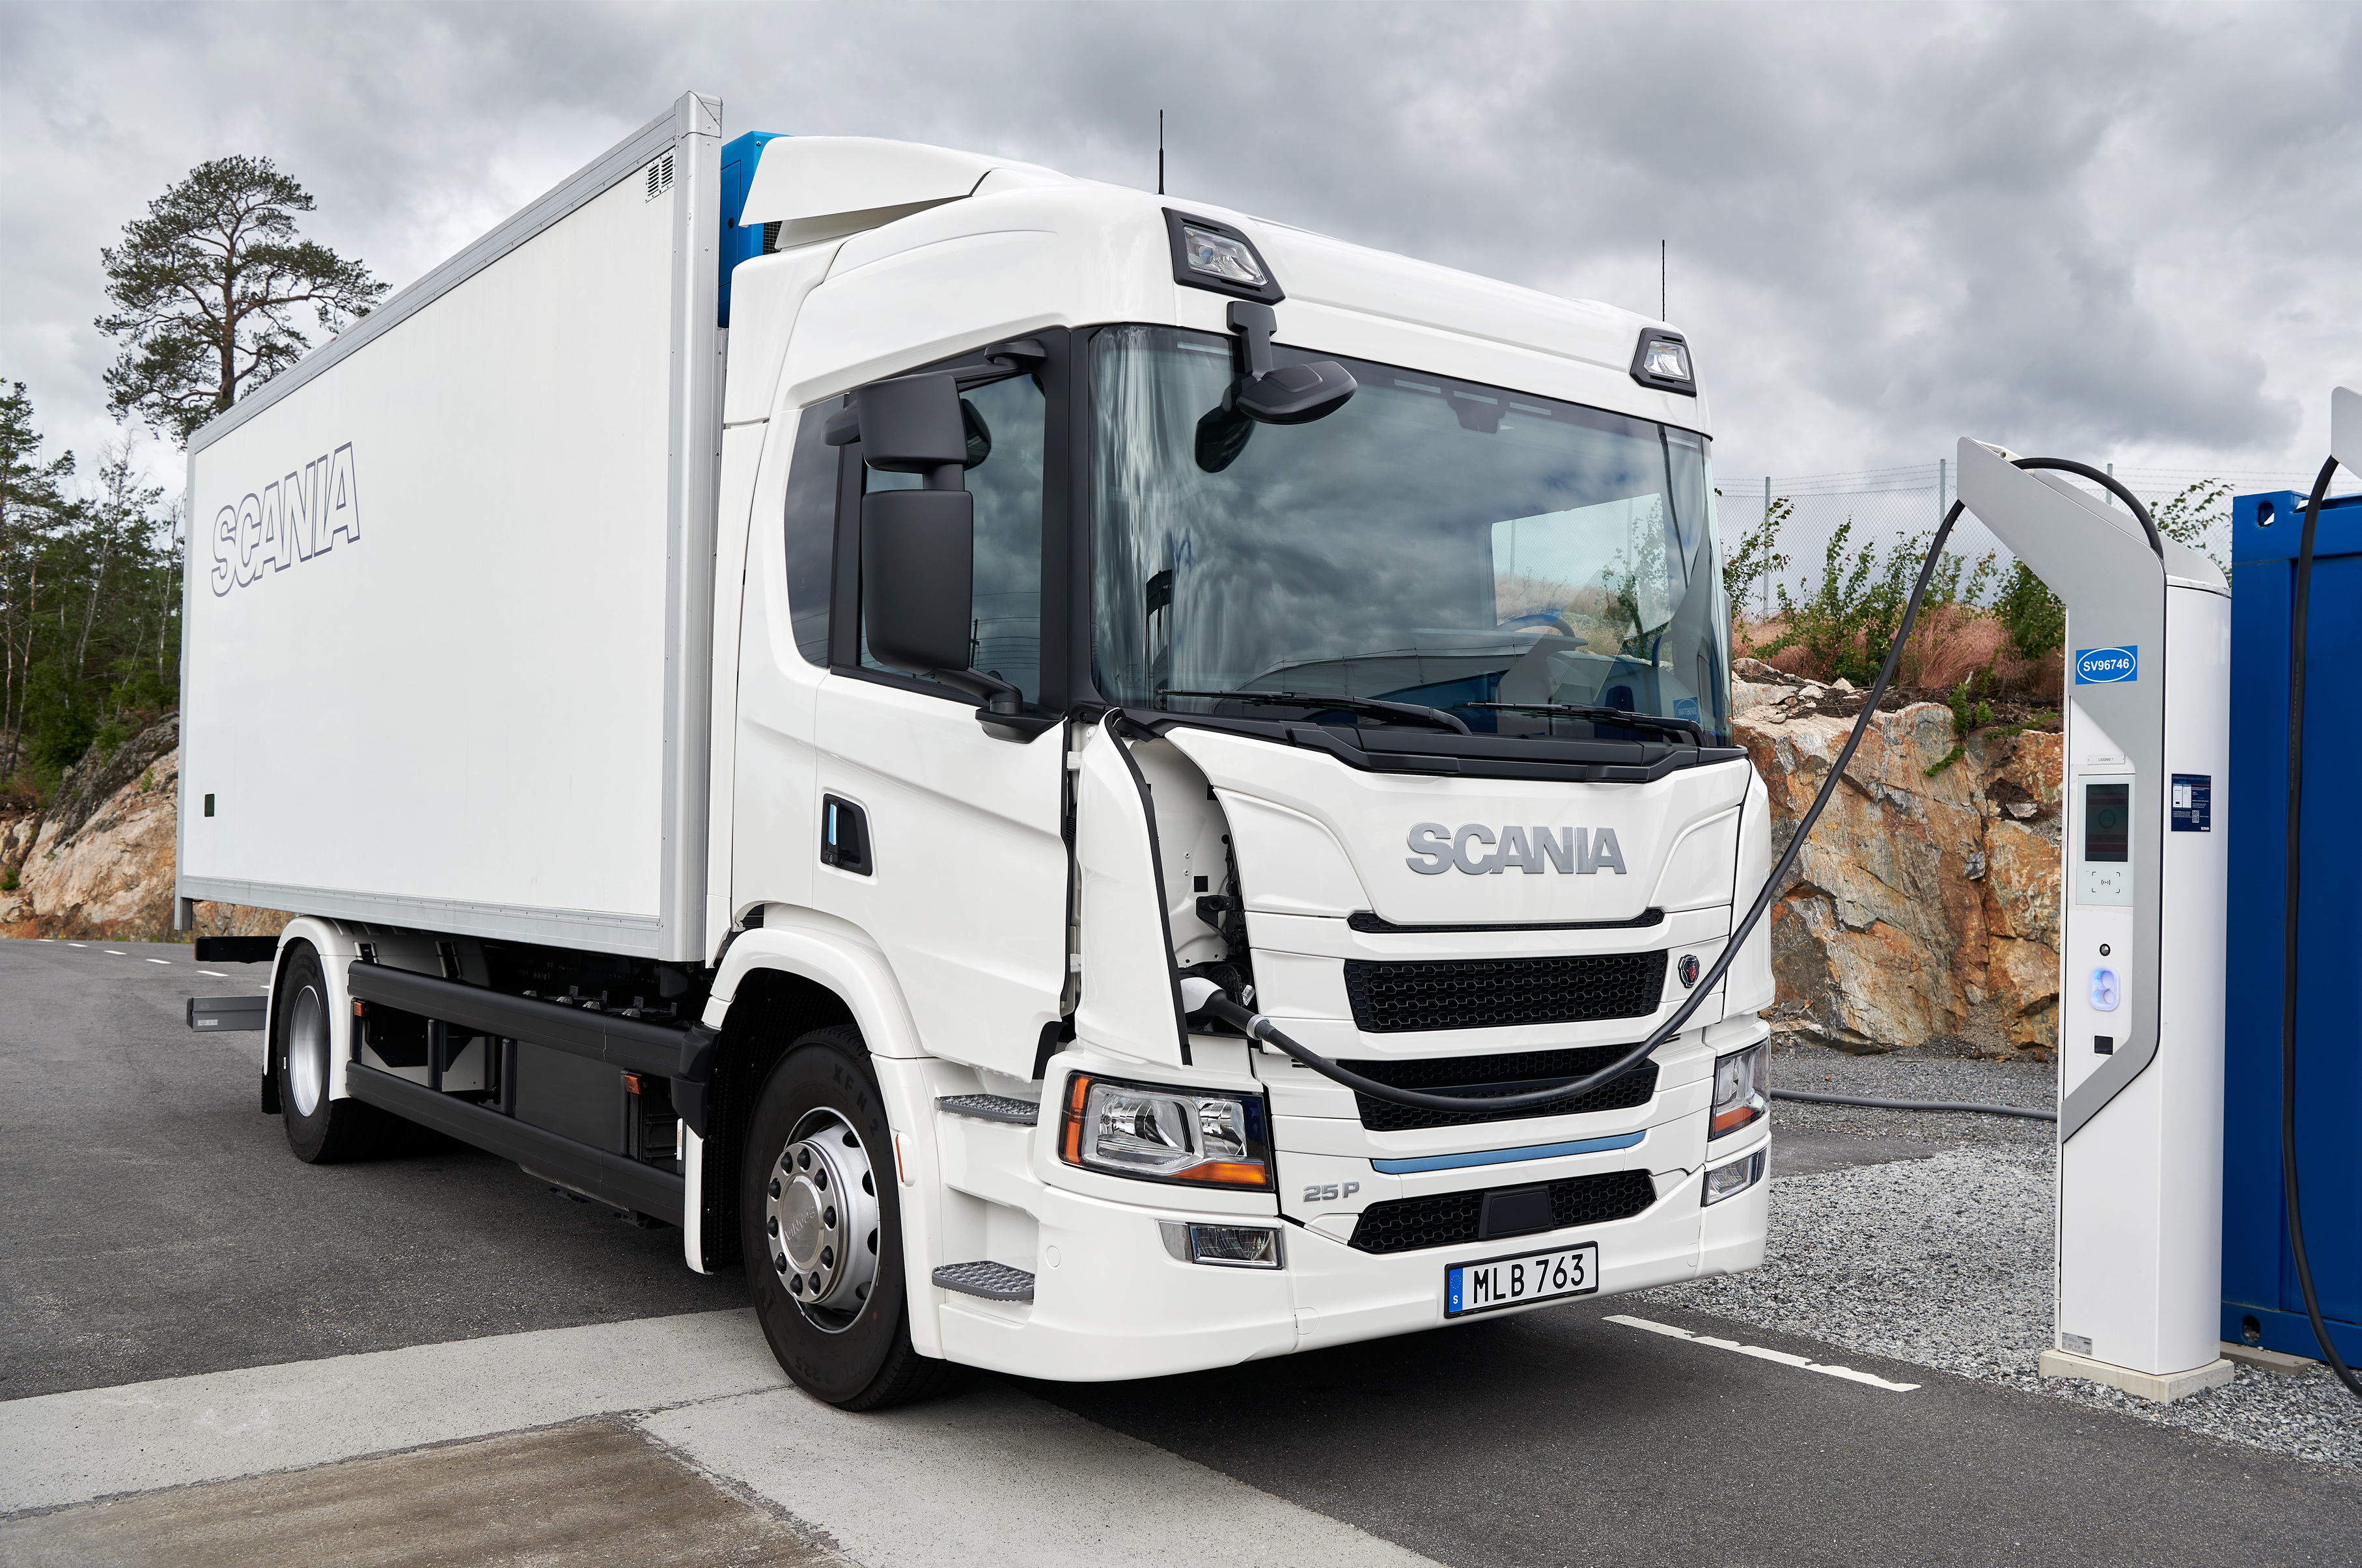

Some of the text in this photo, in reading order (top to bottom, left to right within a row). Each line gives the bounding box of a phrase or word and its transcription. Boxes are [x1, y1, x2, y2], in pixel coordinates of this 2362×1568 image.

[211, 441, 360, 598] SCANIA
[2083, 658, 2130, 672] SV96746
[1406, 821, 1627, 875] SCANIA
[1303, 1181, 1359, 1202] 25 P
[784, 1205, 816, 1241] SCANIA
[1452, 1254, 1585, 1304] S MLB 763
